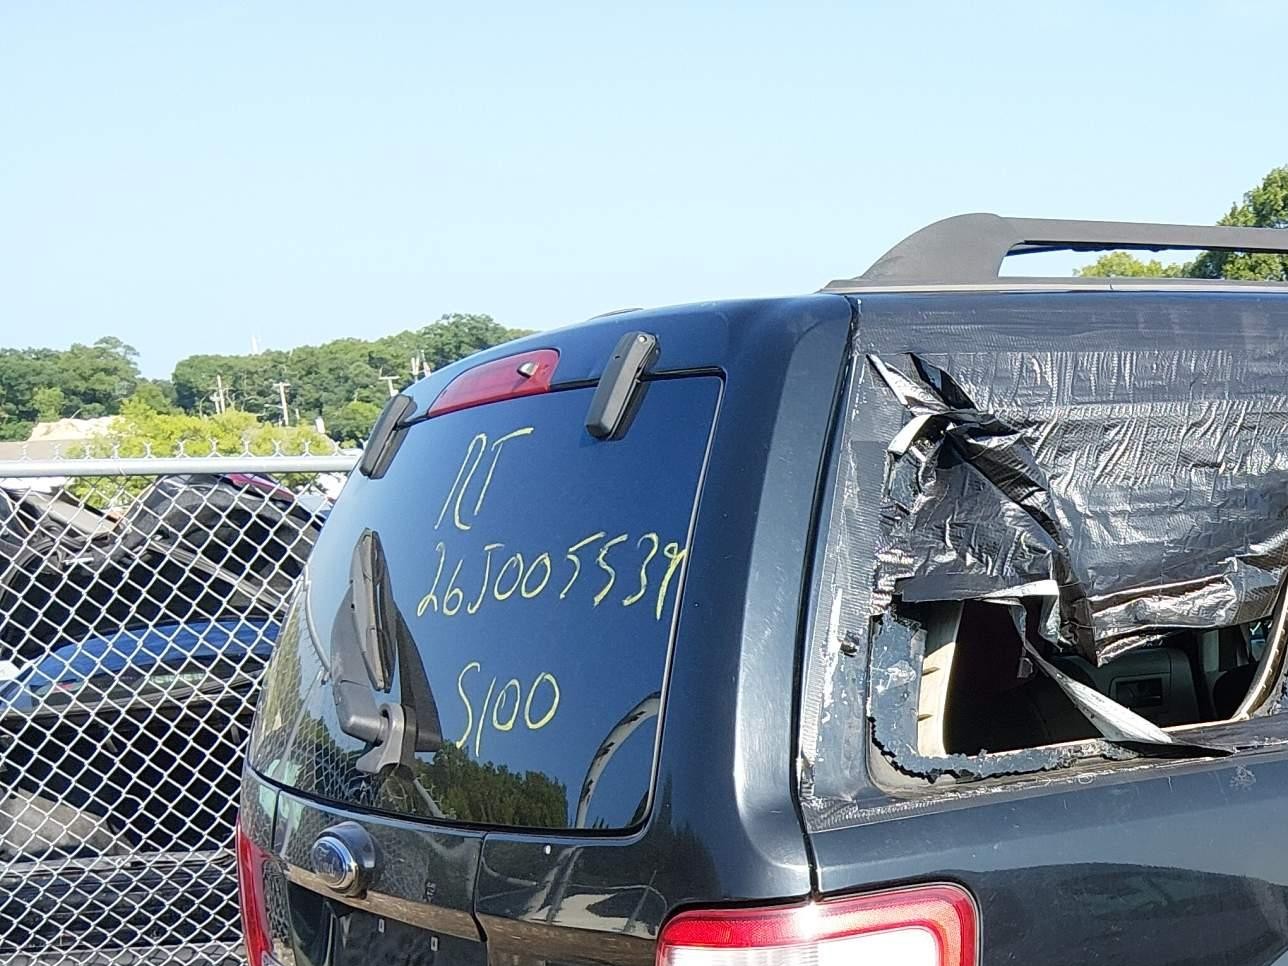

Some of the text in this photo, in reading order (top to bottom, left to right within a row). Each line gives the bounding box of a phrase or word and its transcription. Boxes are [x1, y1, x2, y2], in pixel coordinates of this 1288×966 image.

[435, 427, 533, 530] RT
[416, 531, 688, 621] 26J005539
[455, 661, 561, 758] S100
